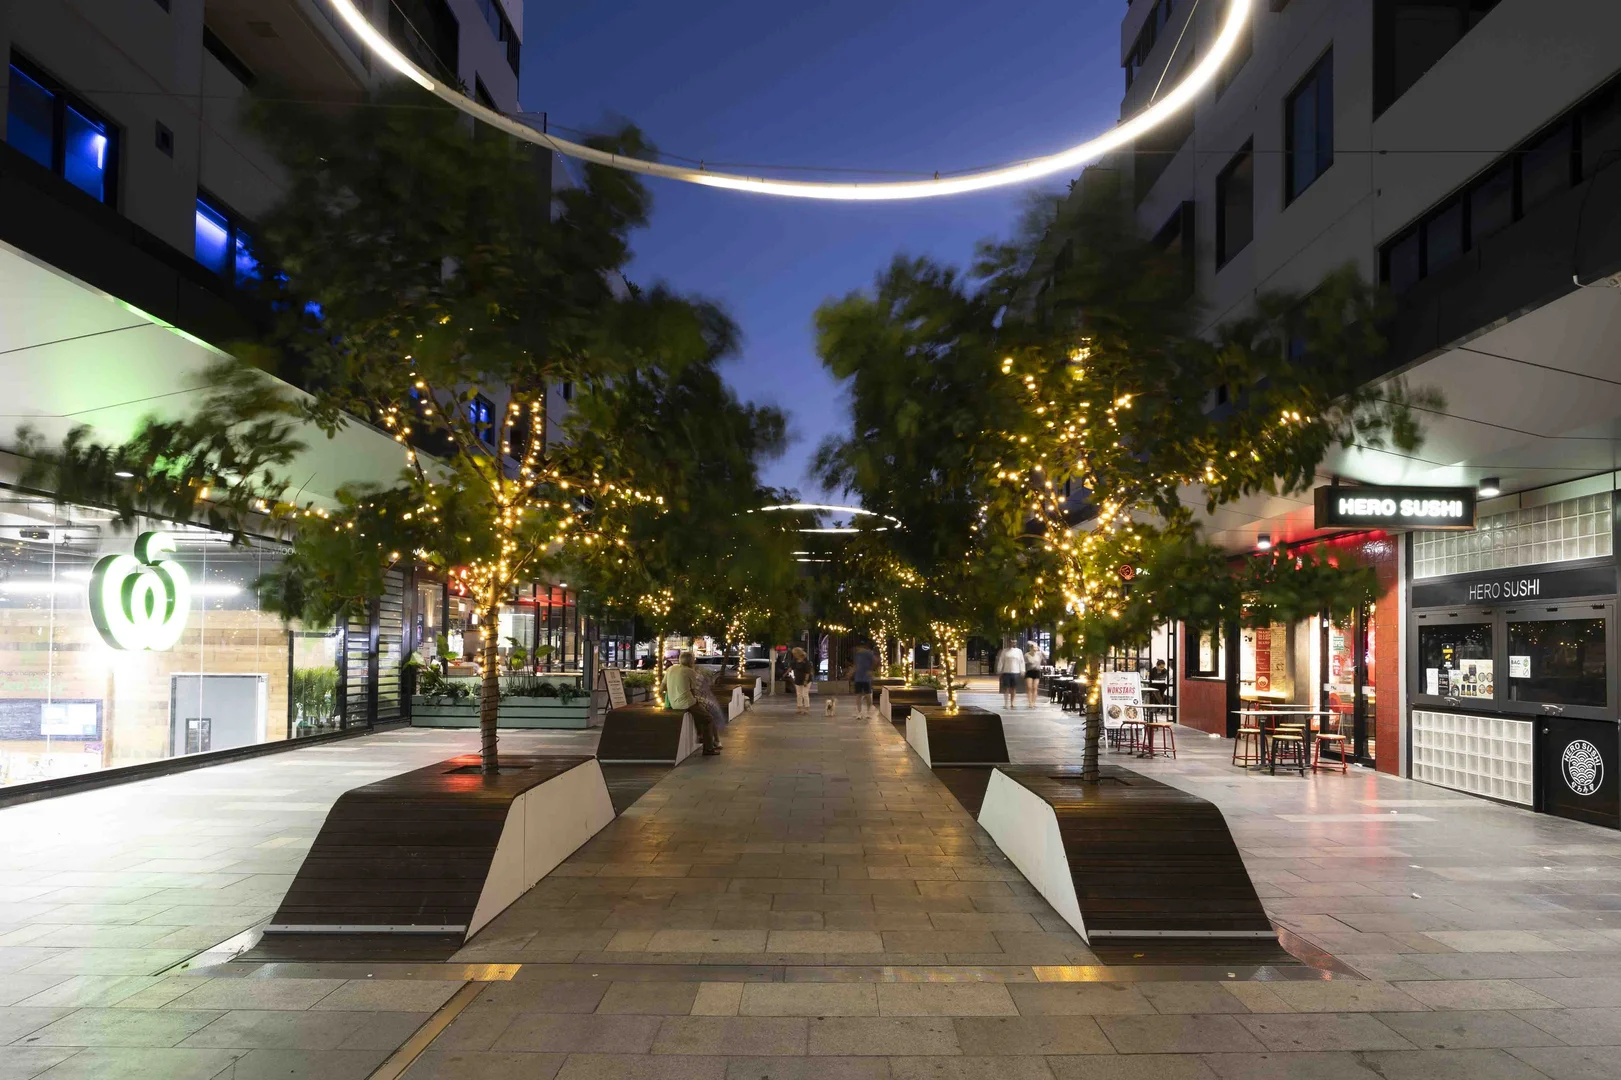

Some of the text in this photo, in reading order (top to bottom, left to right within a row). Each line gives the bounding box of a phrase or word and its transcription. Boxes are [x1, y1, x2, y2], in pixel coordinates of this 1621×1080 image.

[1338, 498, 1463, 518] HERO SUSHI
[1469, 578, 1540, 600] HERO SUSHI
[1564, 742, 1602, 766] HERO SUSHI
